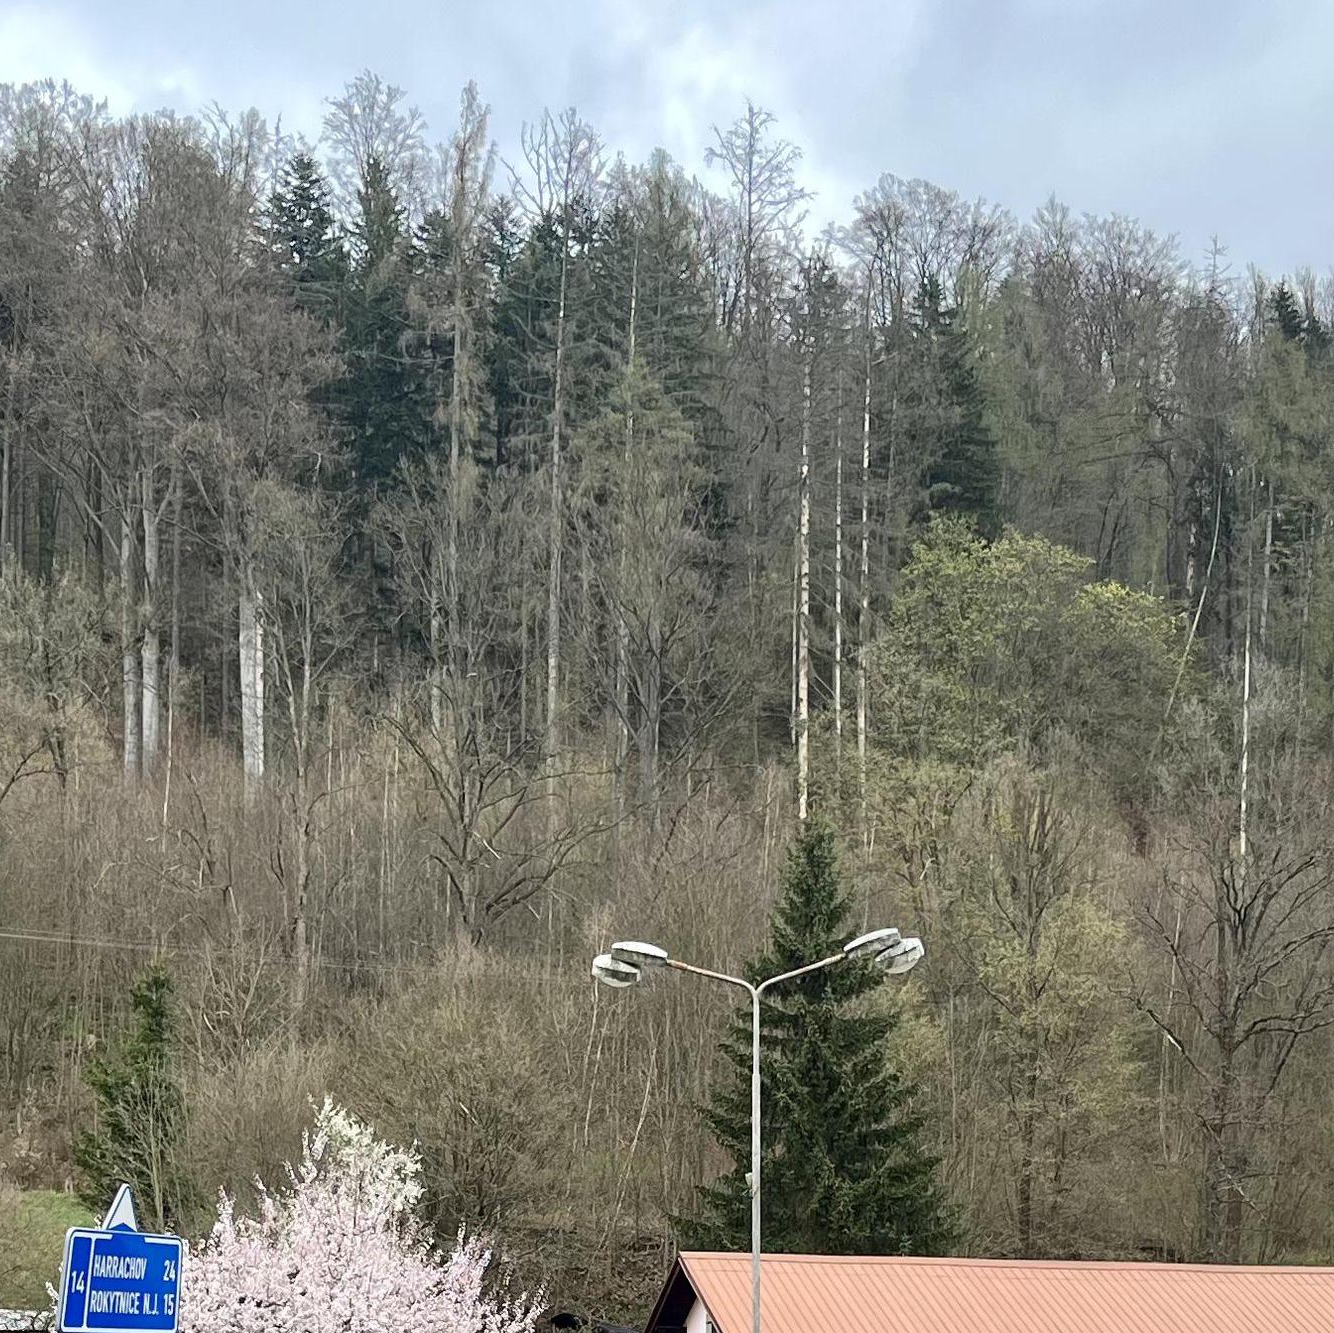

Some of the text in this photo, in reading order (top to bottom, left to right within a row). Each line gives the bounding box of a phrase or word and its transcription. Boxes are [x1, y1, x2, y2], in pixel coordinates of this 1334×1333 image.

[93, 1255, 176, 1282] HARRACHOV 24
[71, 1270, 85, 1294] 14
[90, 1290, 175, 1316] ROKYTNICE N.J. 15
